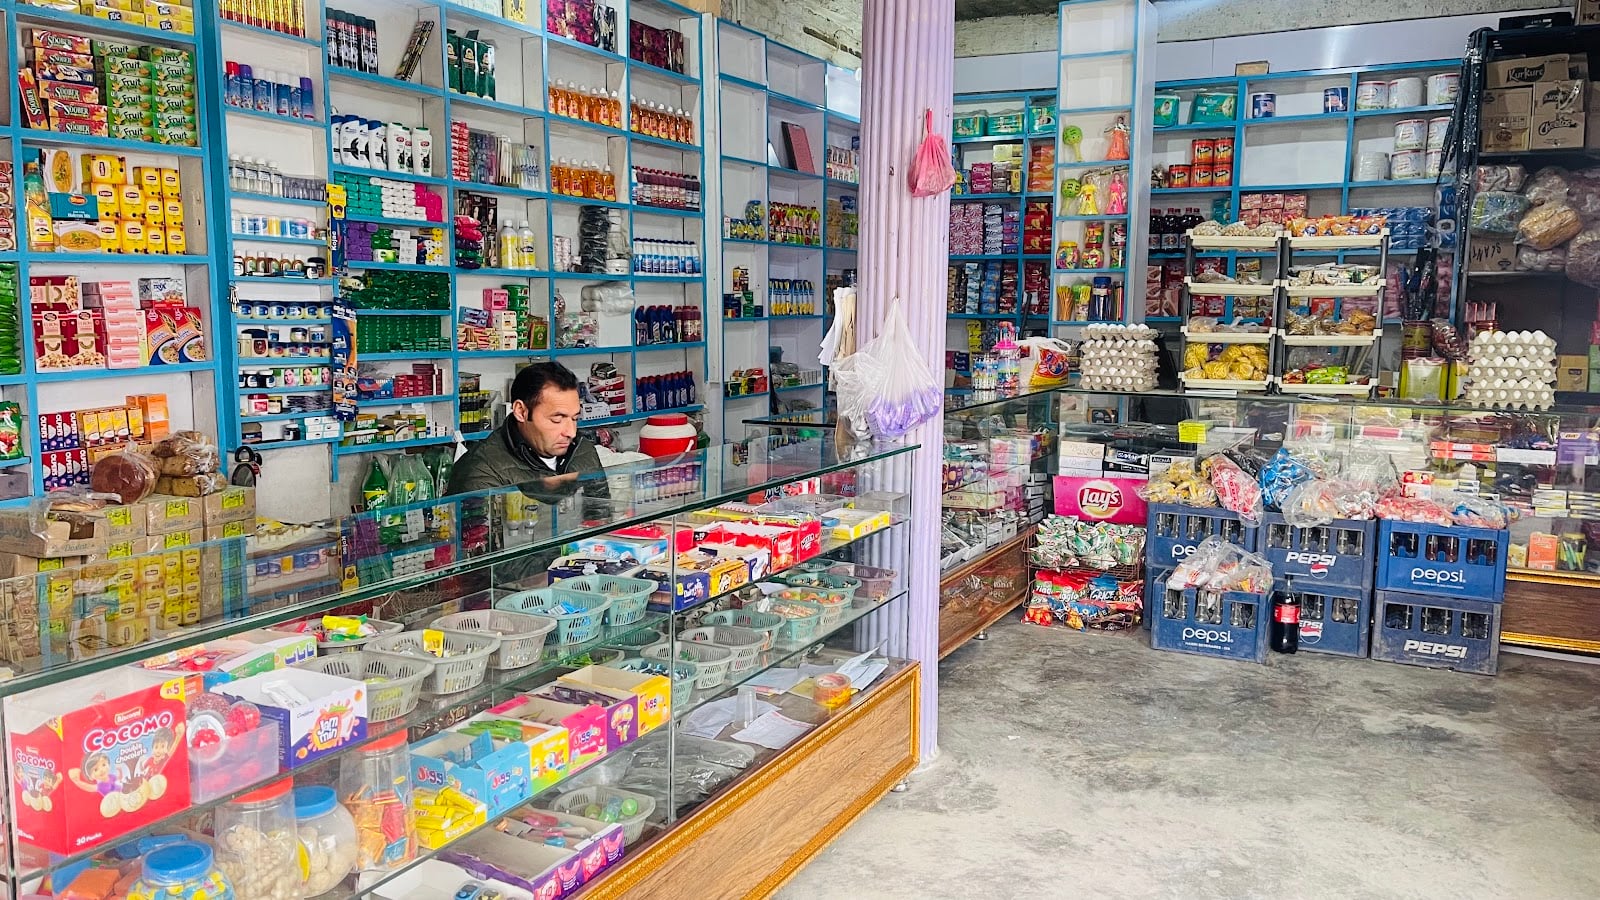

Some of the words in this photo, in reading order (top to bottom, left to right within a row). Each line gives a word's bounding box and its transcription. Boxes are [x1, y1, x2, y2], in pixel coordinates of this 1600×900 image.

[109, 45, 128, 54] Fruit
[120, 61, 140, 69] Fruit
[167, 67, 184, 76] Fruit
[121, 78, 140, 88] Fruit
[167, 84, 184, 92] Fruit
[122, 95, 141, 104] Fruit
[167, 100, 184, 109] Fruit
[124, 112, 143, 122] Fruit
[168, 116, 185, 125] Fruit
[124, 130, 143, 138] Fruit
[168, 132, 187, 141] Fruit
[1286, 552, 1336, 566] PEPSI
[1412, 567, 1464, 583] pepsi
[1298, 620, 1323, 629] EPSI
[1182, 627, 1231, 643] pepsi
[1403, 640, 1468, 658] PEPSI
[174, 683, 180, 694] 5
